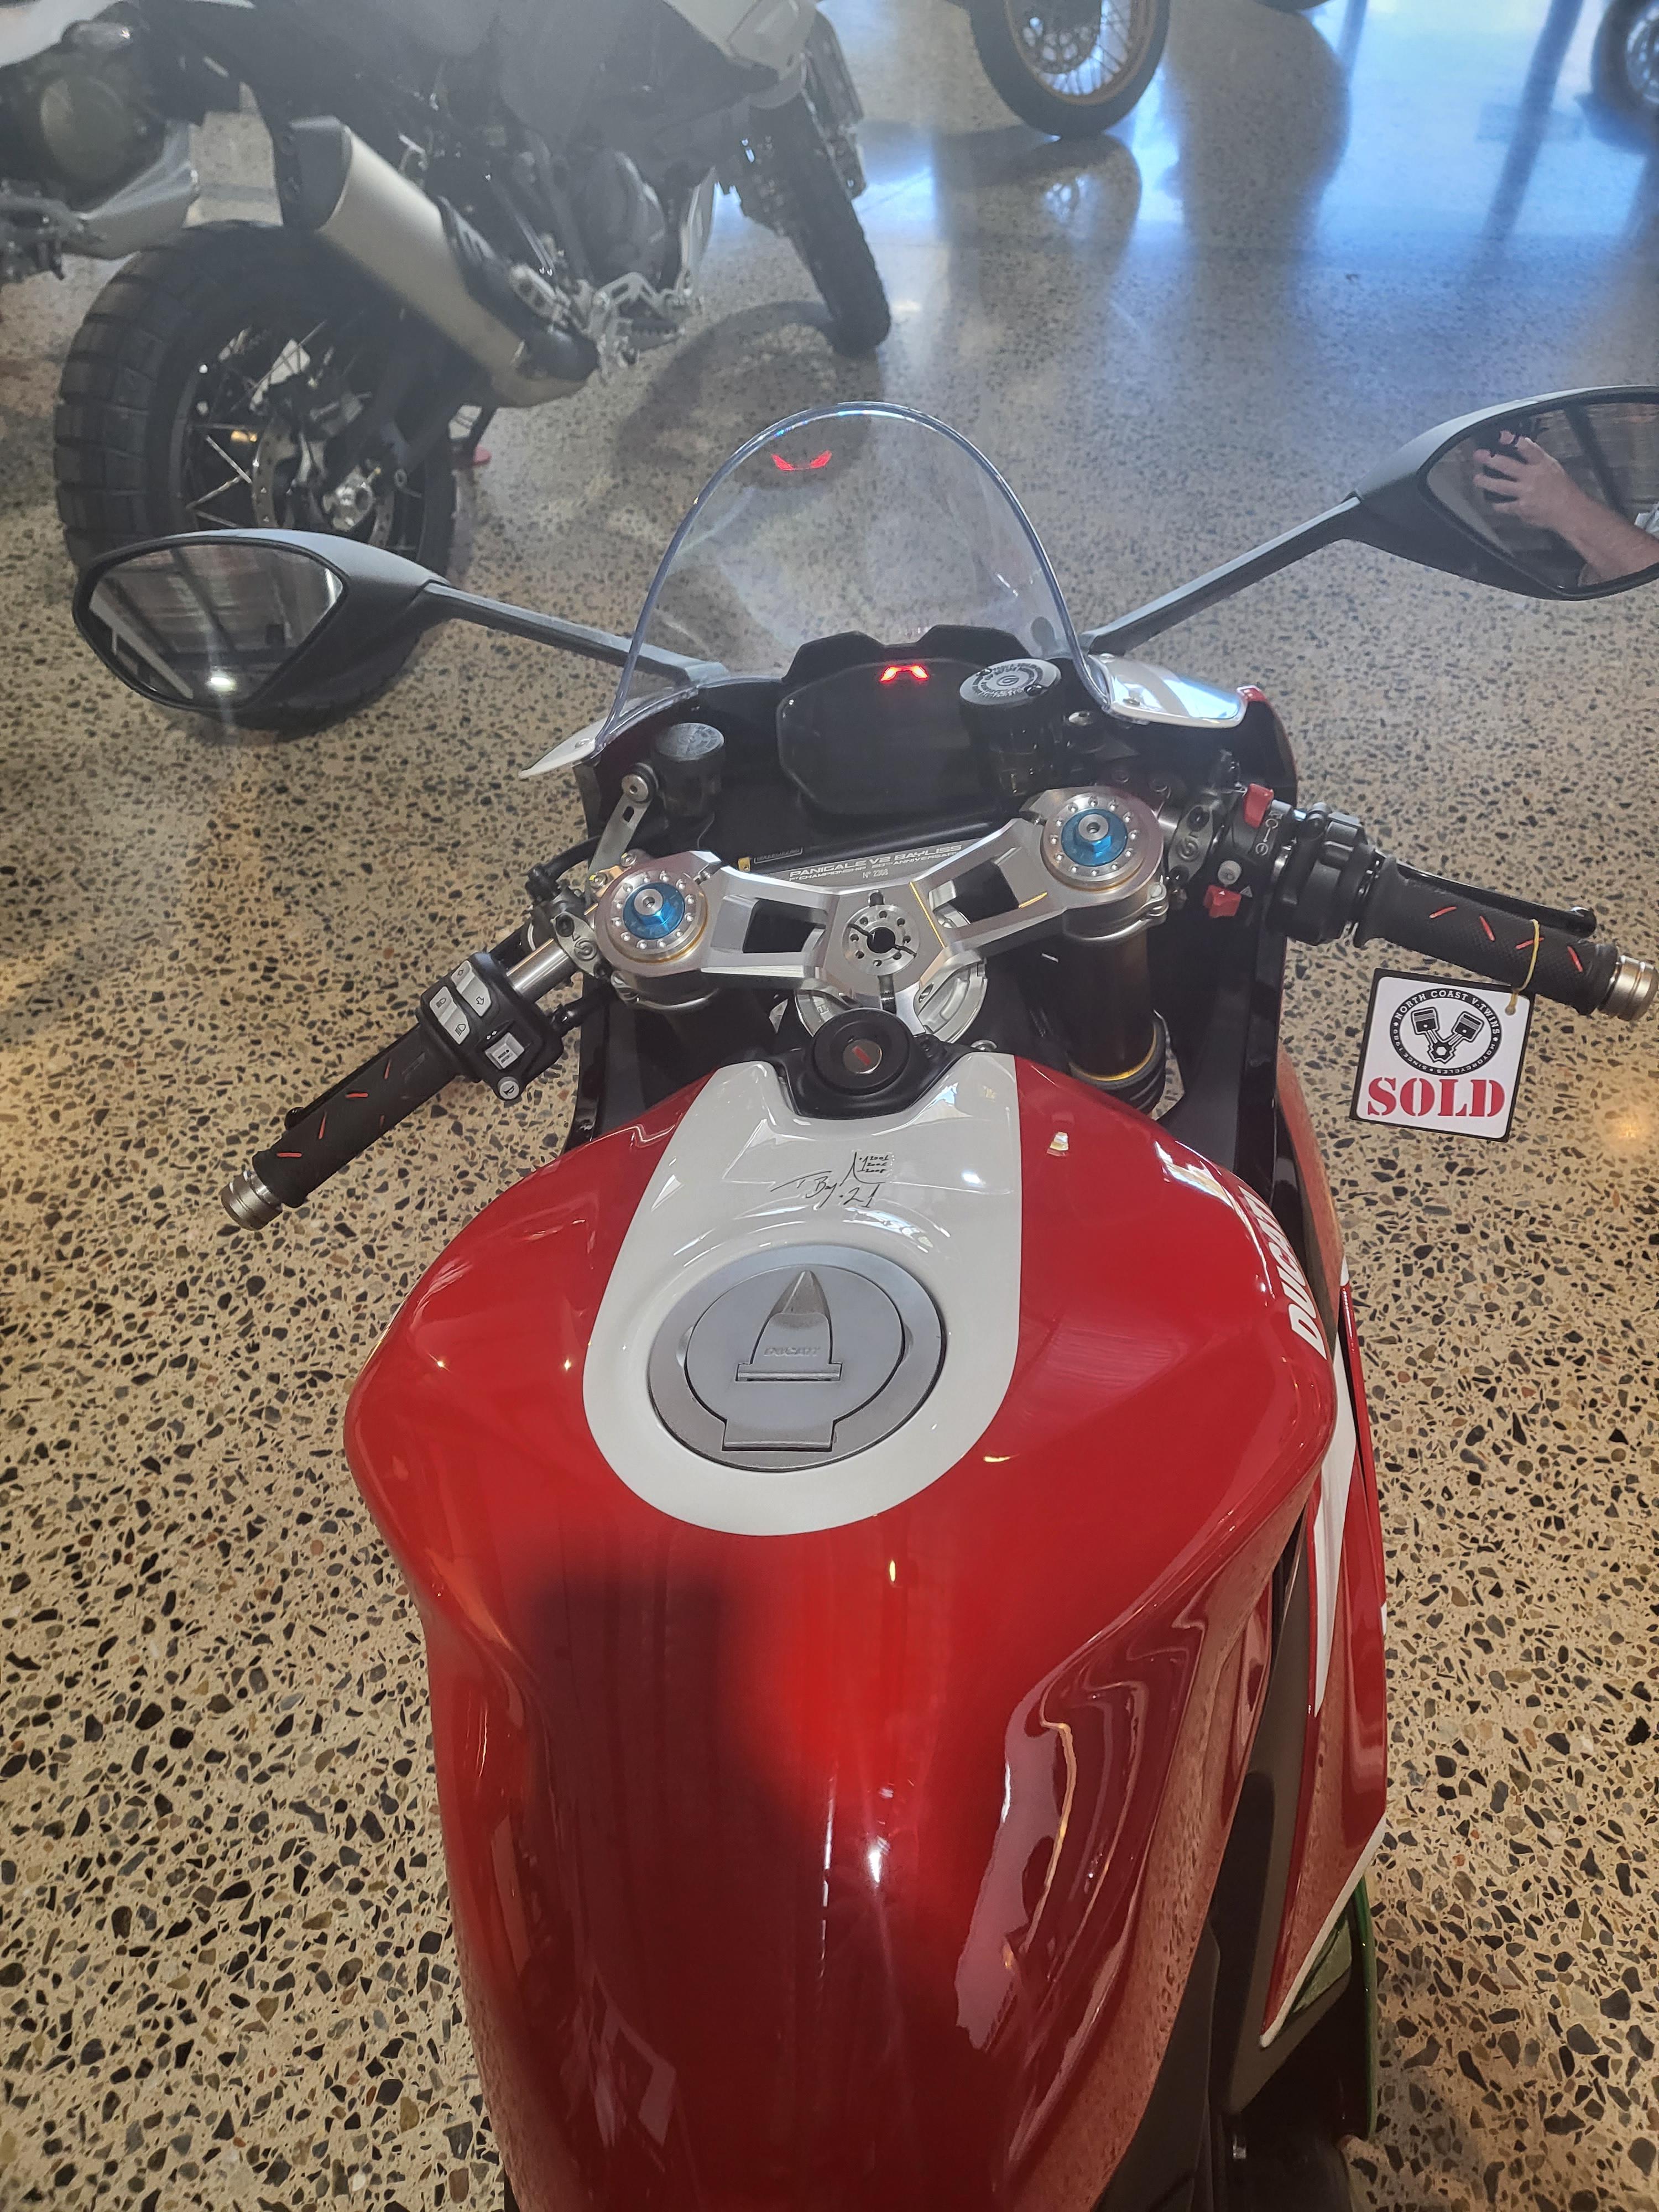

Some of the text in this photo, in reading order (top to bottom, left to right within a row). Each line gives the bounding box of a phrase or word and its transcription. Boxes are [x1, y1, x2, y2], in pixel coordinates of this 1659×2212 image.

[790, 860, 867, 877] PANIGALE
[895, 845, 962, 860] BAYLISS
[1396, 993, 1426, 1020] NORTH
[1431, 990, 1468, 1001] COAST
[1403, 1053, 1427, 1070] SINCE
[1436, 1043, 1495, 1074] MOTORCYCLES
[1367, 1076, 1505, 1118] SOLD
[1238, 1185, 1326, 1360] DUCATI
